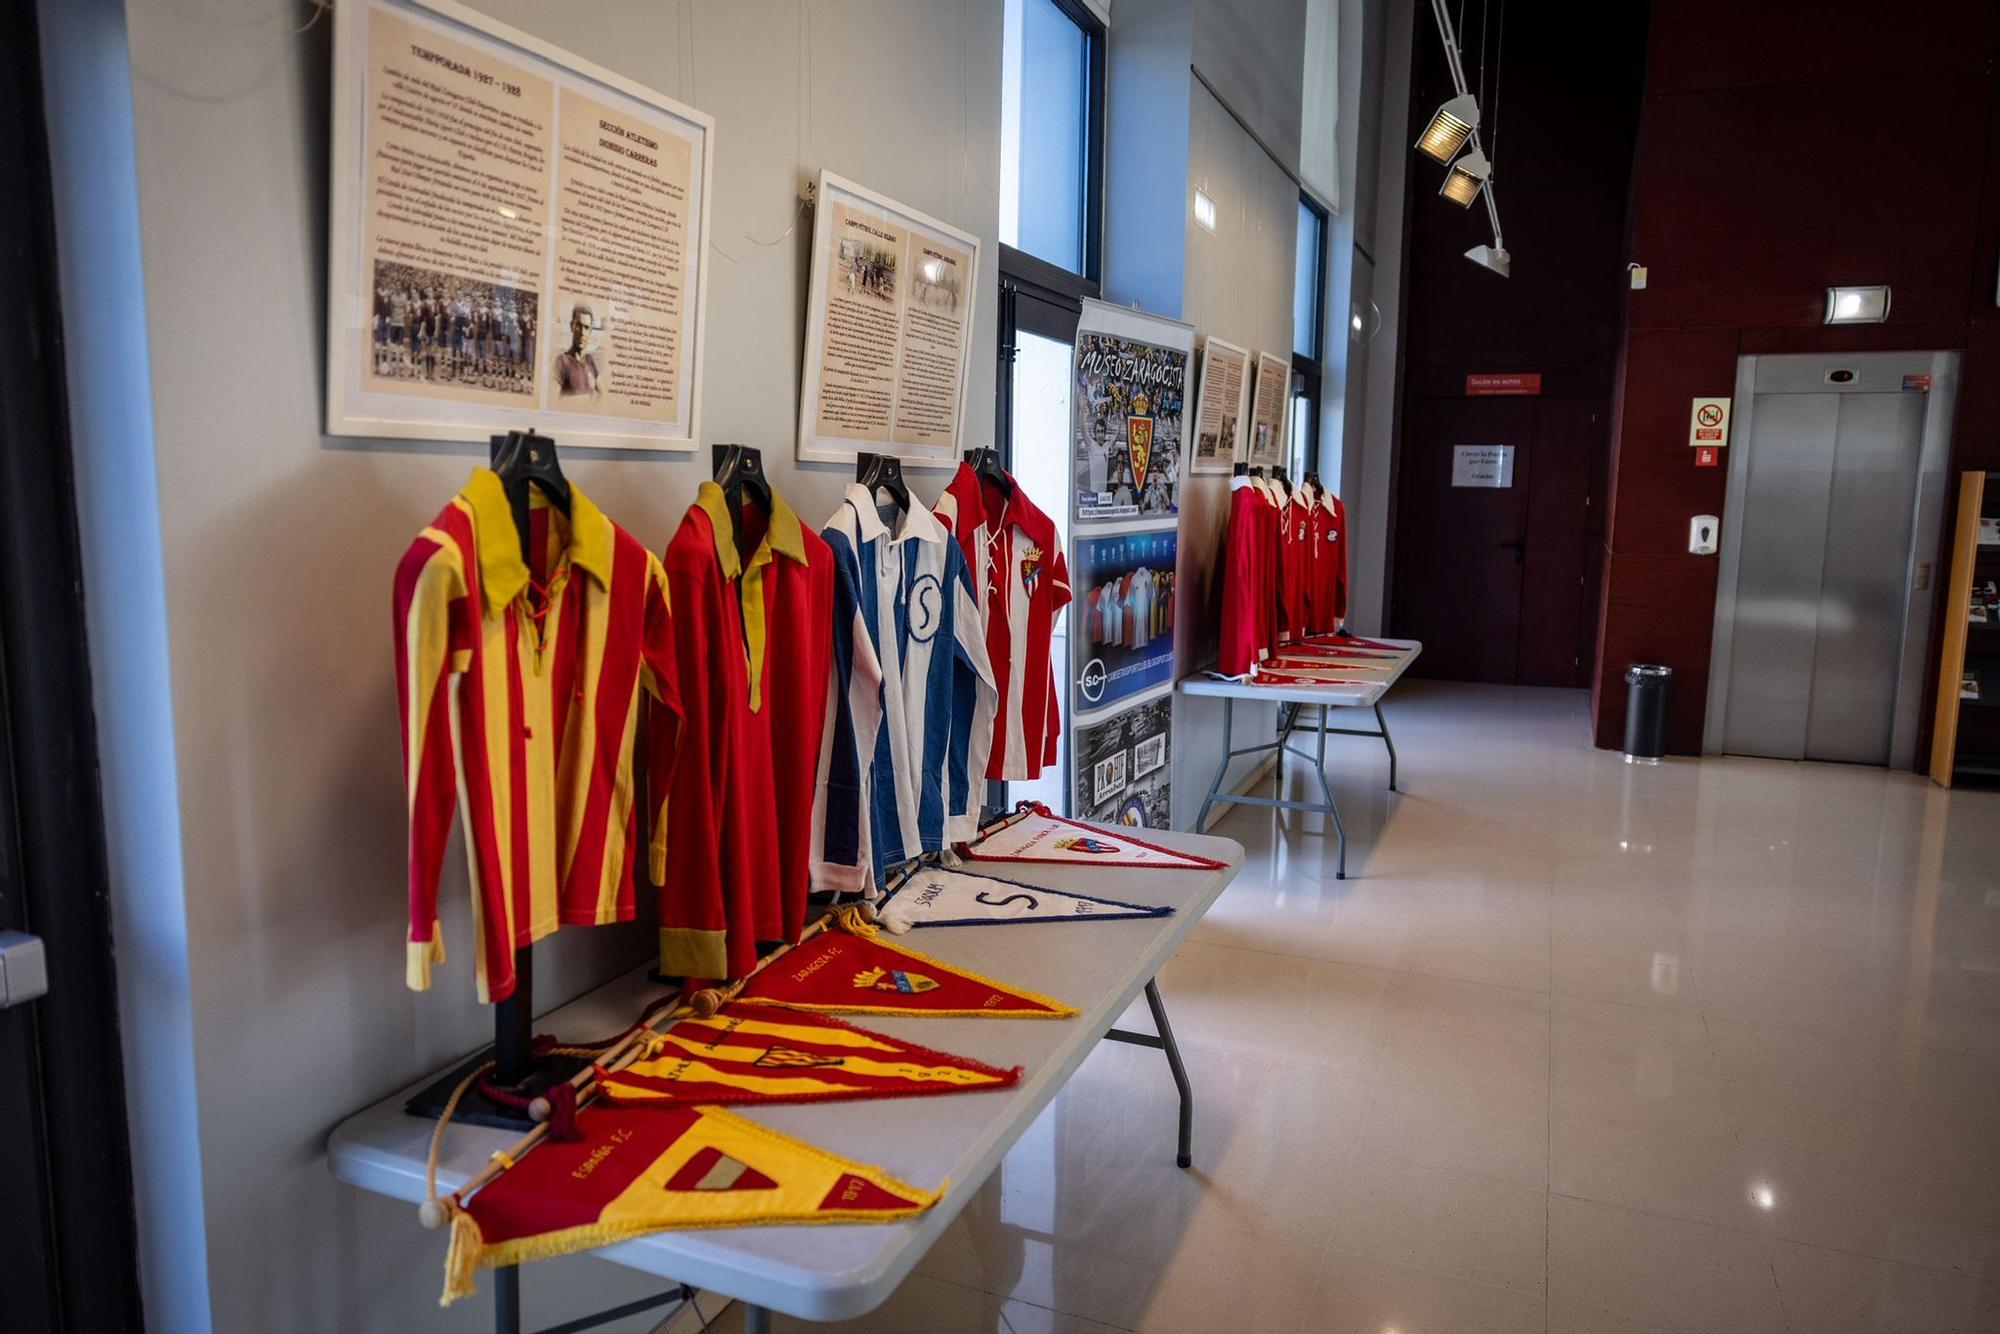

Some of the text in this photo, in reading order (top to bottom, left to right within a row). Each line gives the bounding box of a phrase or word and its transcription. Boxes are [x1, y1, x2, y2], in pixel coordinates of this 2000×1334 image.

[626, 148, 658, 167] CARRERAS
[1080, 350, 1183, 390] MUSEO ZARAGOCISTA
[920, 586, 933, 630] S
[976, 891, 1039, 911] S
